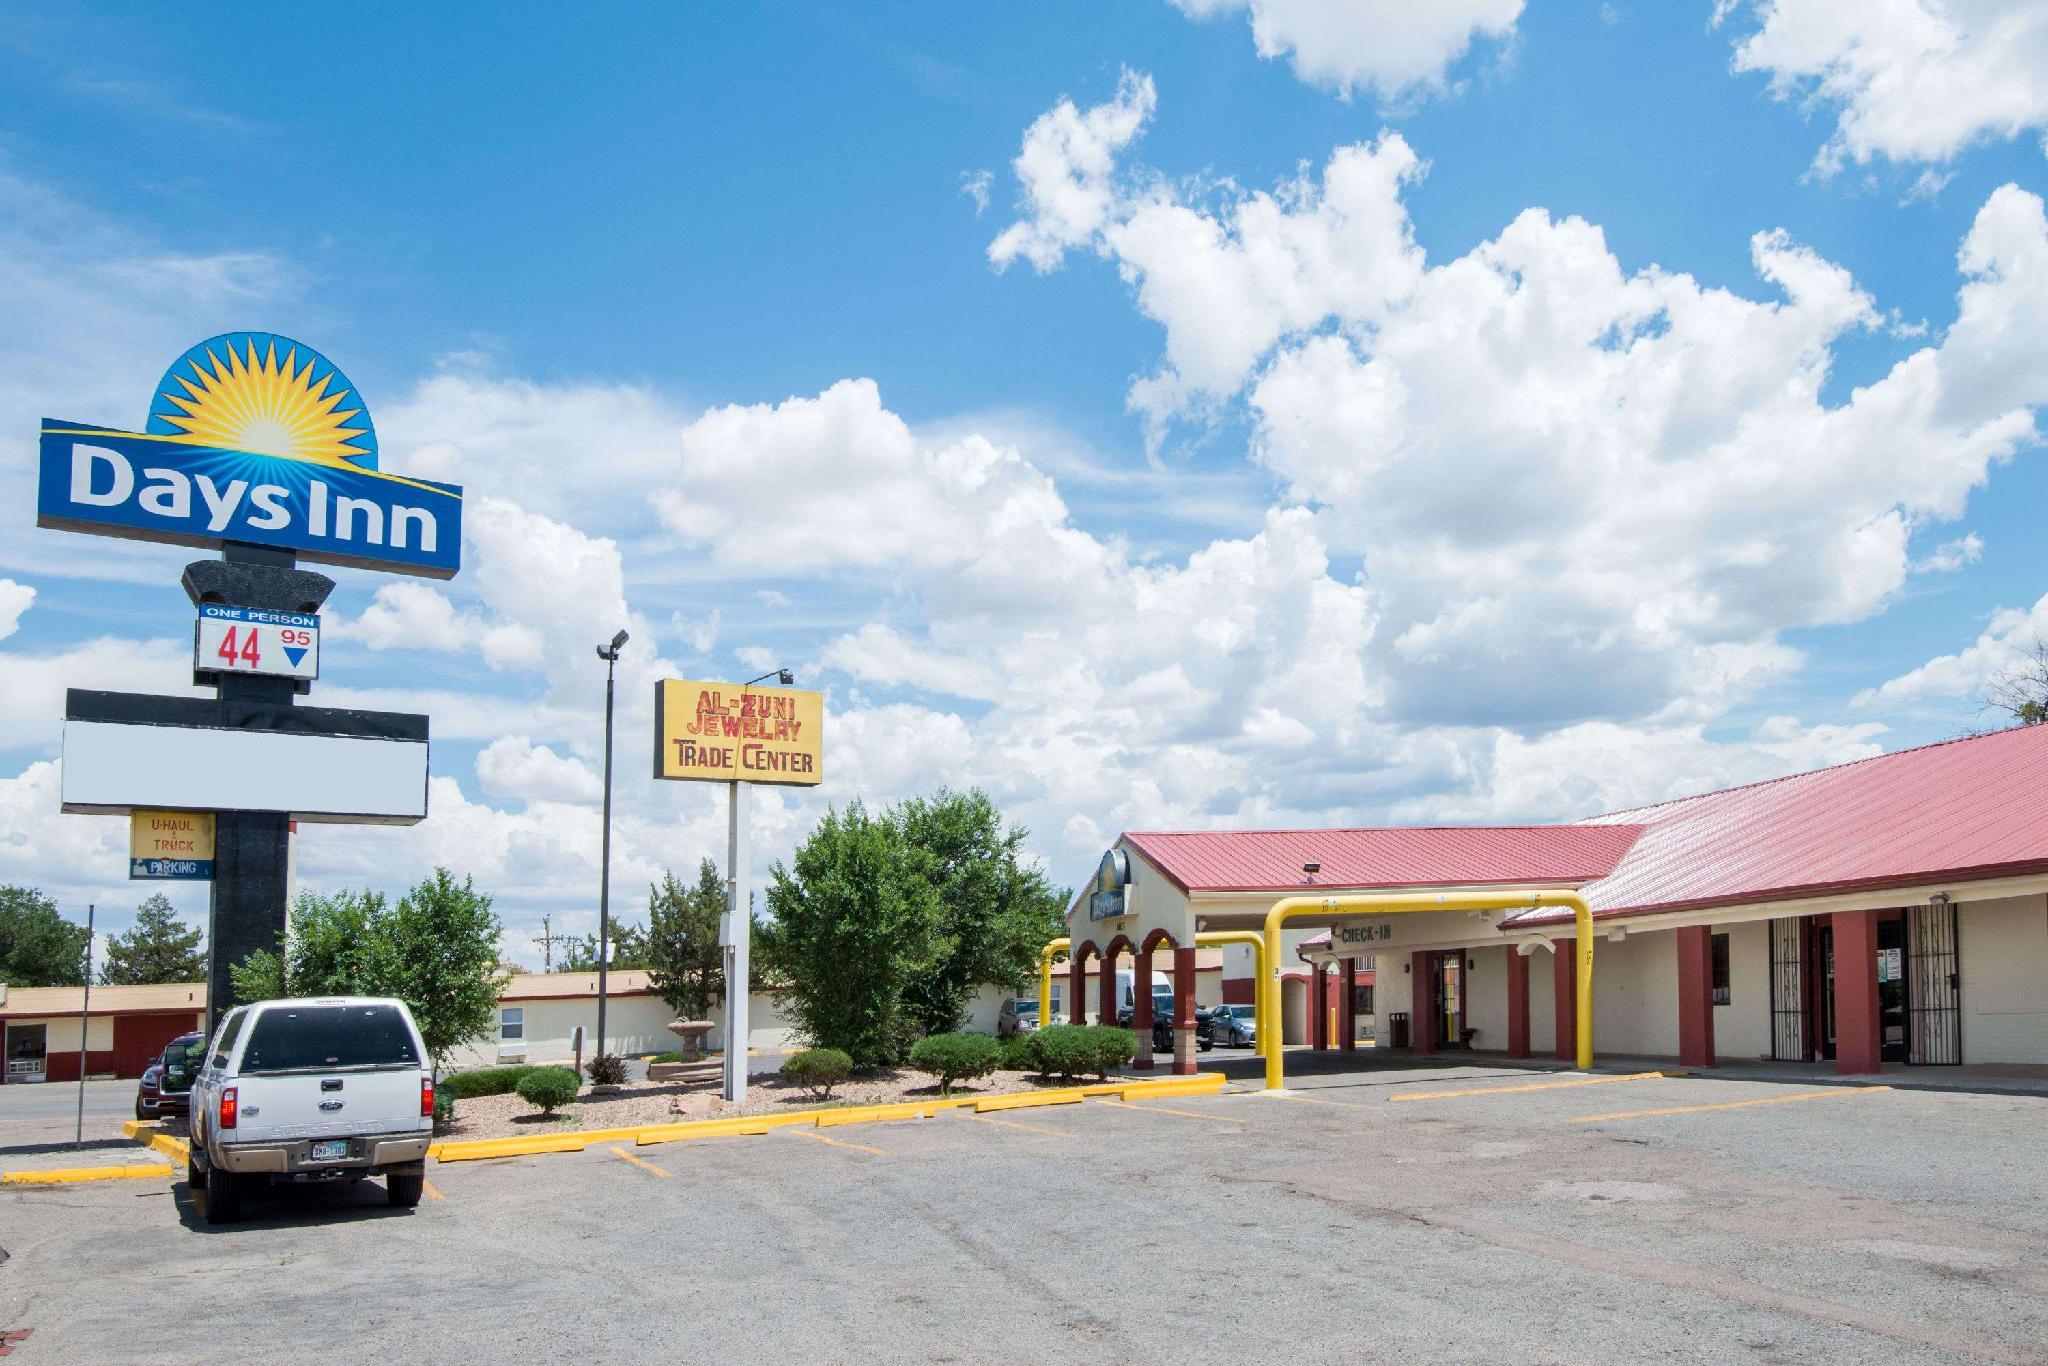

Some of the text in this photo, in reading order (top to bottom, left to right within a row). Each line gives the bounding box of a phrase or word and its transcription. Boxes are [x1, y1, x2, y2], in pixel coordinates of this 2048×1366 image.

[69, 443, 438, 553] Days Inn
[206, 607, 314, 627] ONE PERSON
[217, 625, 311, 669] 44 95
[695, 690, 796, 721] AL-ZUNI
[686, 712, 802, 742] JEWELRY
[672, 738, 813, 773] TRADE CENTER
[151, 819, 195, 831] U-HAUL
[153, 840, 195, 852] TRUCK
[150, 861, 197, 874] PARKING
